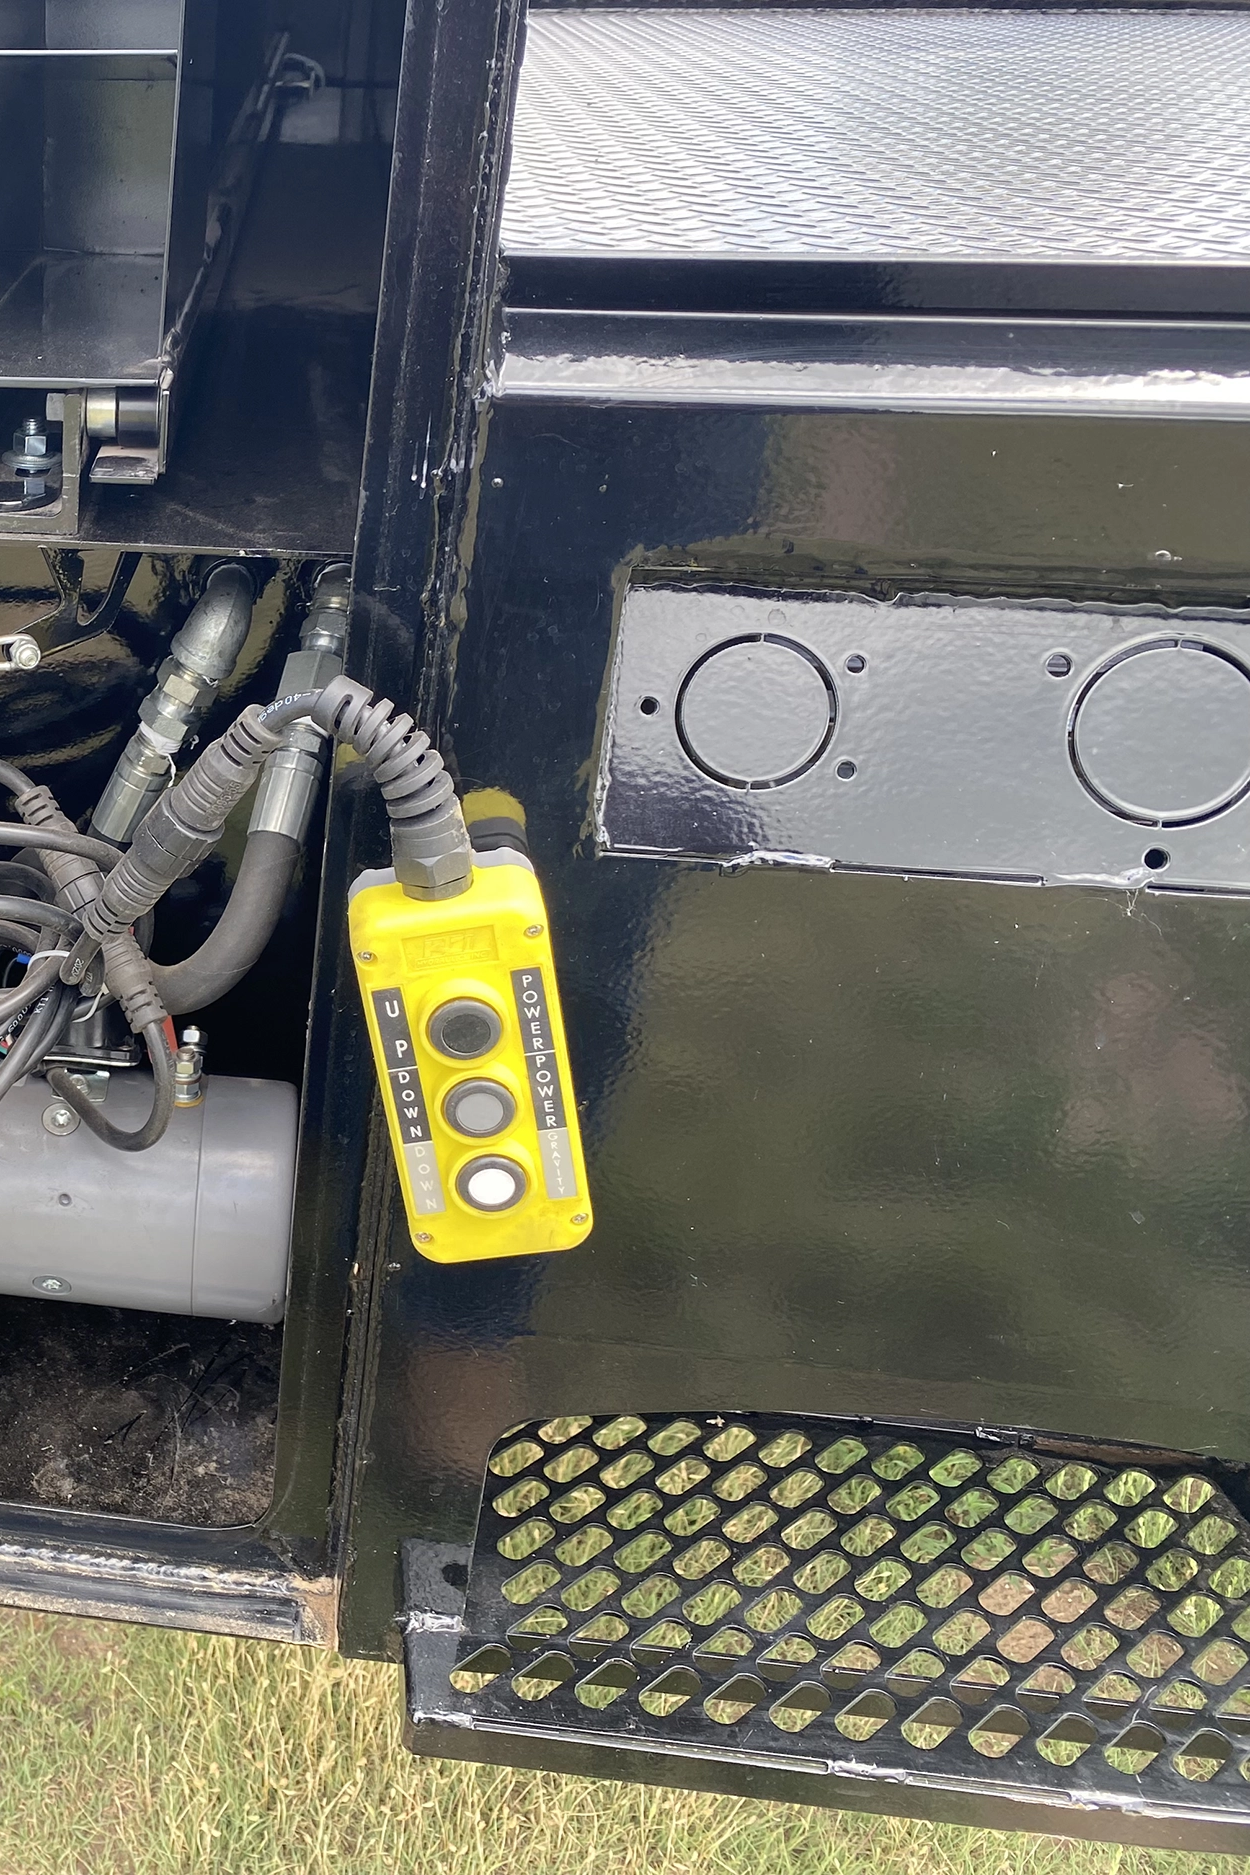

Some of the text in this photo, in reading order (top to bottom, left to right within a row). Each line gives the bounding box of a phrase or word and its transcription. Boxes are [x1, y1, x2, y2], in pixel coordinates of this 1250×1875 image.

[385, 1000, 408, 1058] UP
[522, 975, 544, 1050] POWER
[398, 1072, 423, 1138] DOWN
[535, 1055, 558, 1127] POWER
[414, 1146, 438, 1210] DOWN
[547, 1131, 565, 1195] GRAVITY
